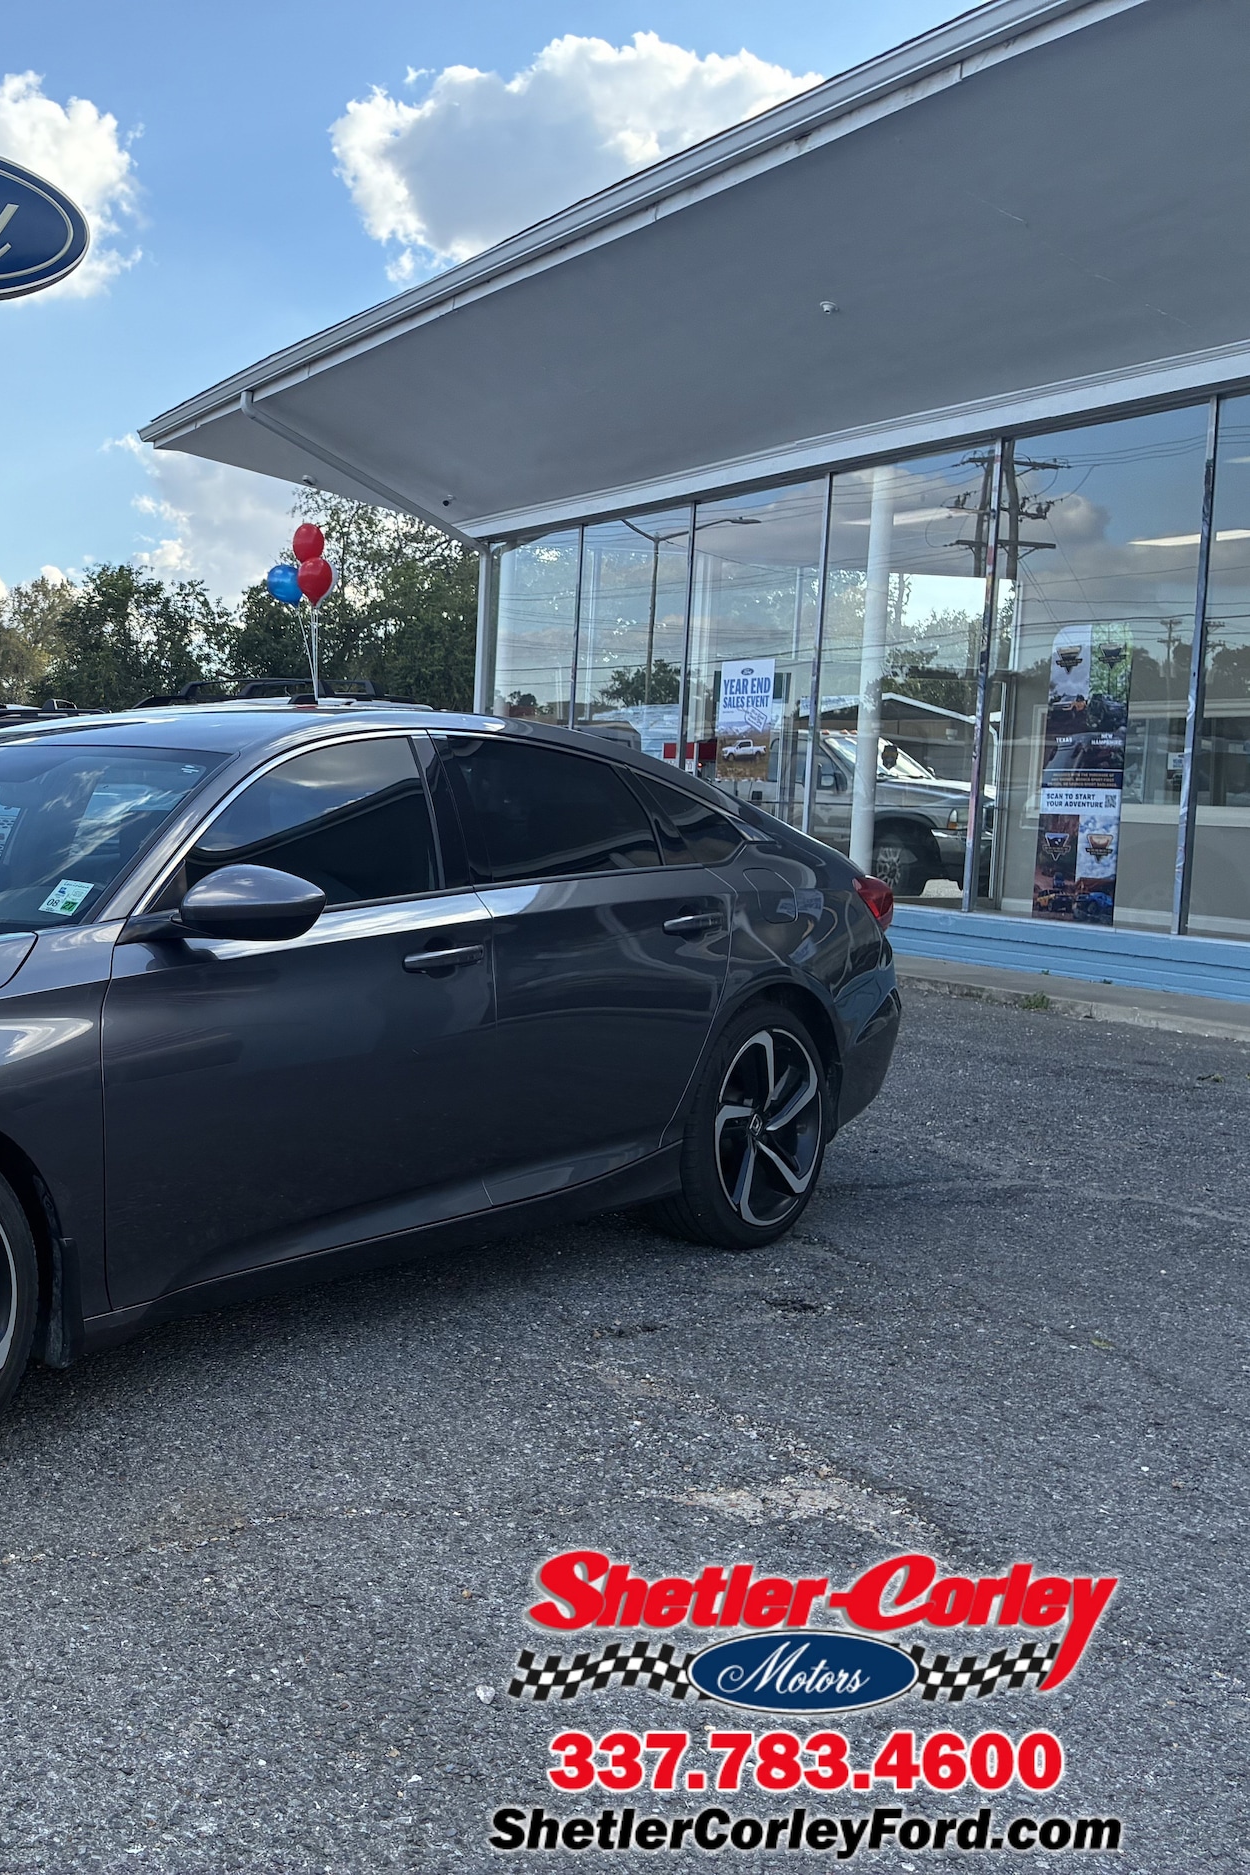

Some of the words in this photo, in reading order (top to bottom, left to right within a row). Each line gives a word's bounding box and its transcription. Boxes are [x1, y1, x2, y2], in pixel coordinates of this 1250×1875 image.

[723, 678, 749, 695] YEAR
[750, 677, 771, 694] END
[723, 696, 745, 709] SALES
[747, 695, 770, 708] EVENT
[64, 881, 90, 889] Louisiana
[46, 898, 60, 907] 08
